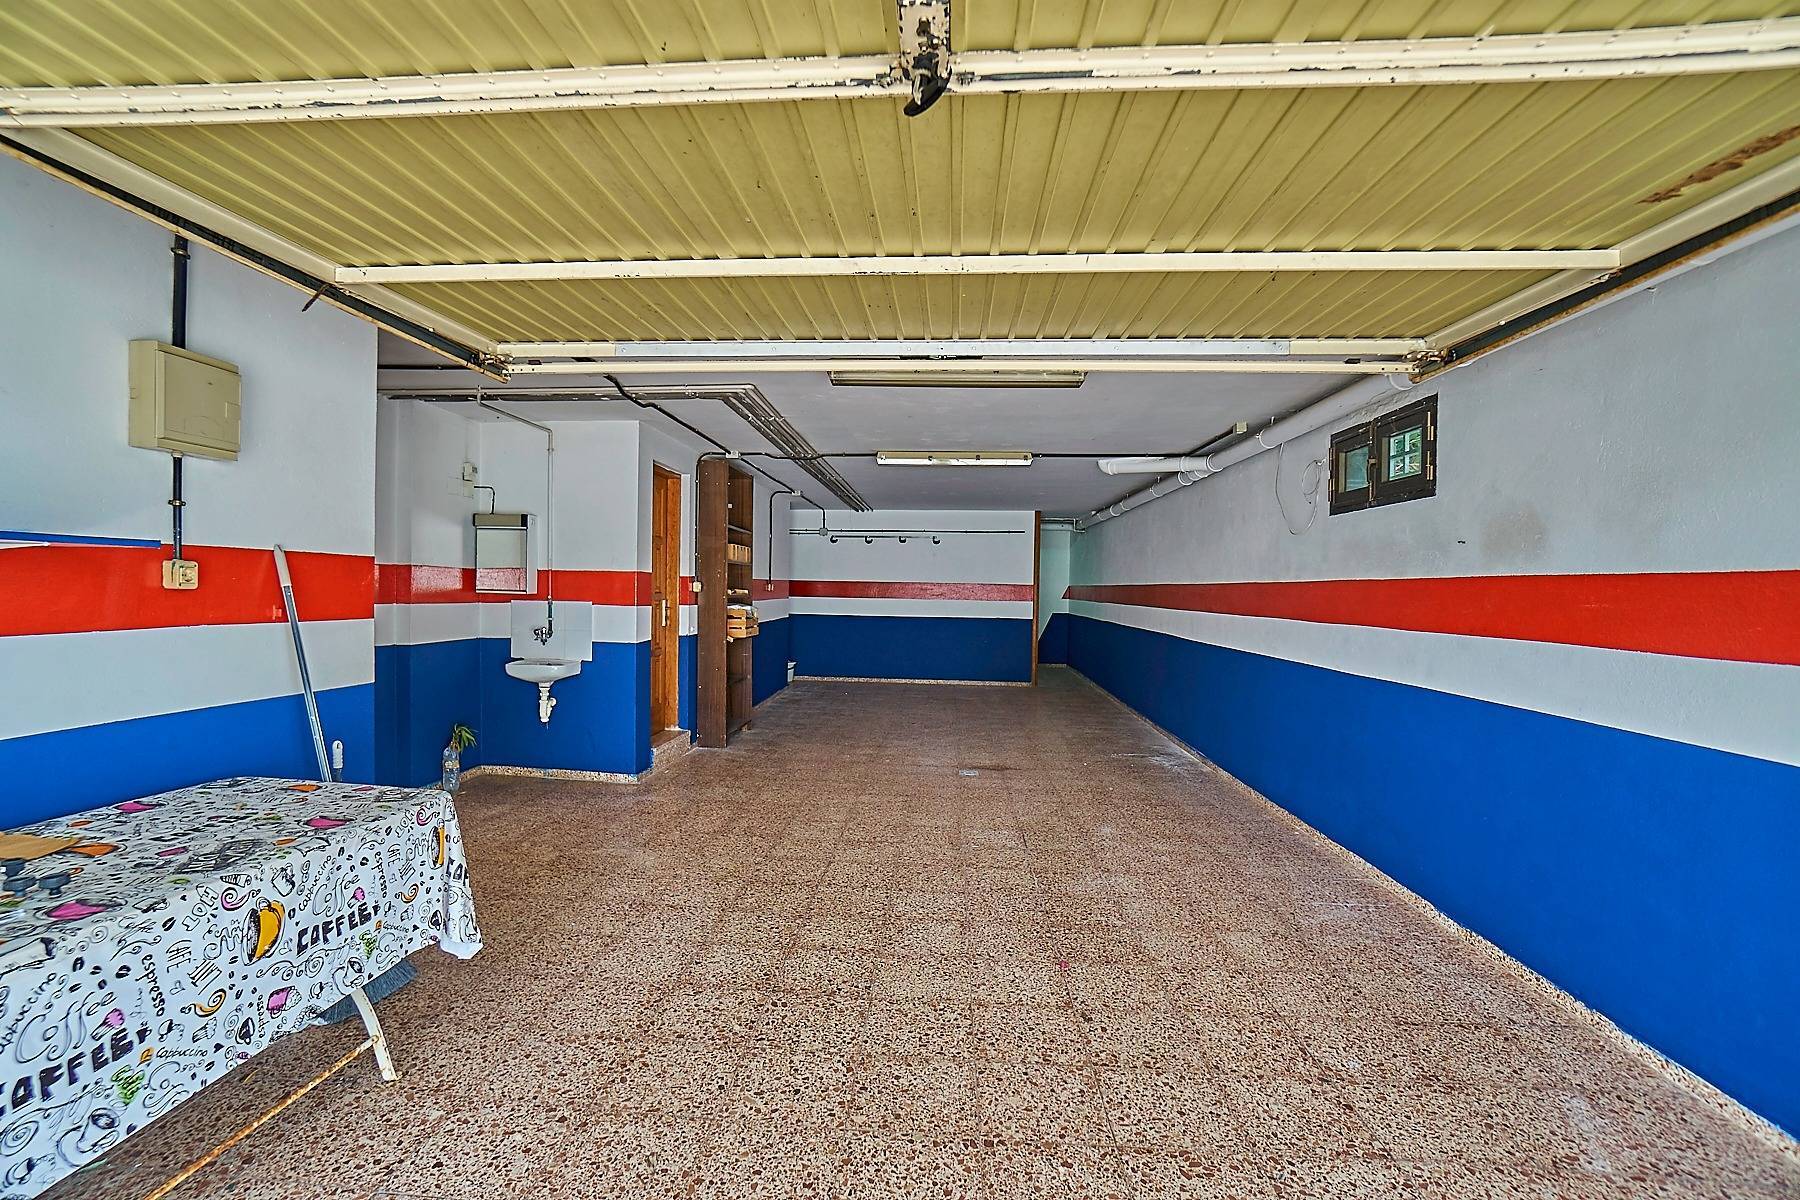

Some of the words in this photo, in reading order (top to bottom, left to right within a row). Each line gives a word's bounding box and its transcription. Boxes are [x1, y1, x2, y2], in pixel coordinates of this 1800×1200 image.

[298, 856, 333, 912] cappuccino
[311, 872, 361, 918] Coffee
[371, 851, 388, 899] espresso
[181, 886, 219, 931] HOT
[135, 953, 166, 1018] espresso
[15, 991, 118, 1065] Coffee
[156, 1045, 209, 1061] Cappuccino
